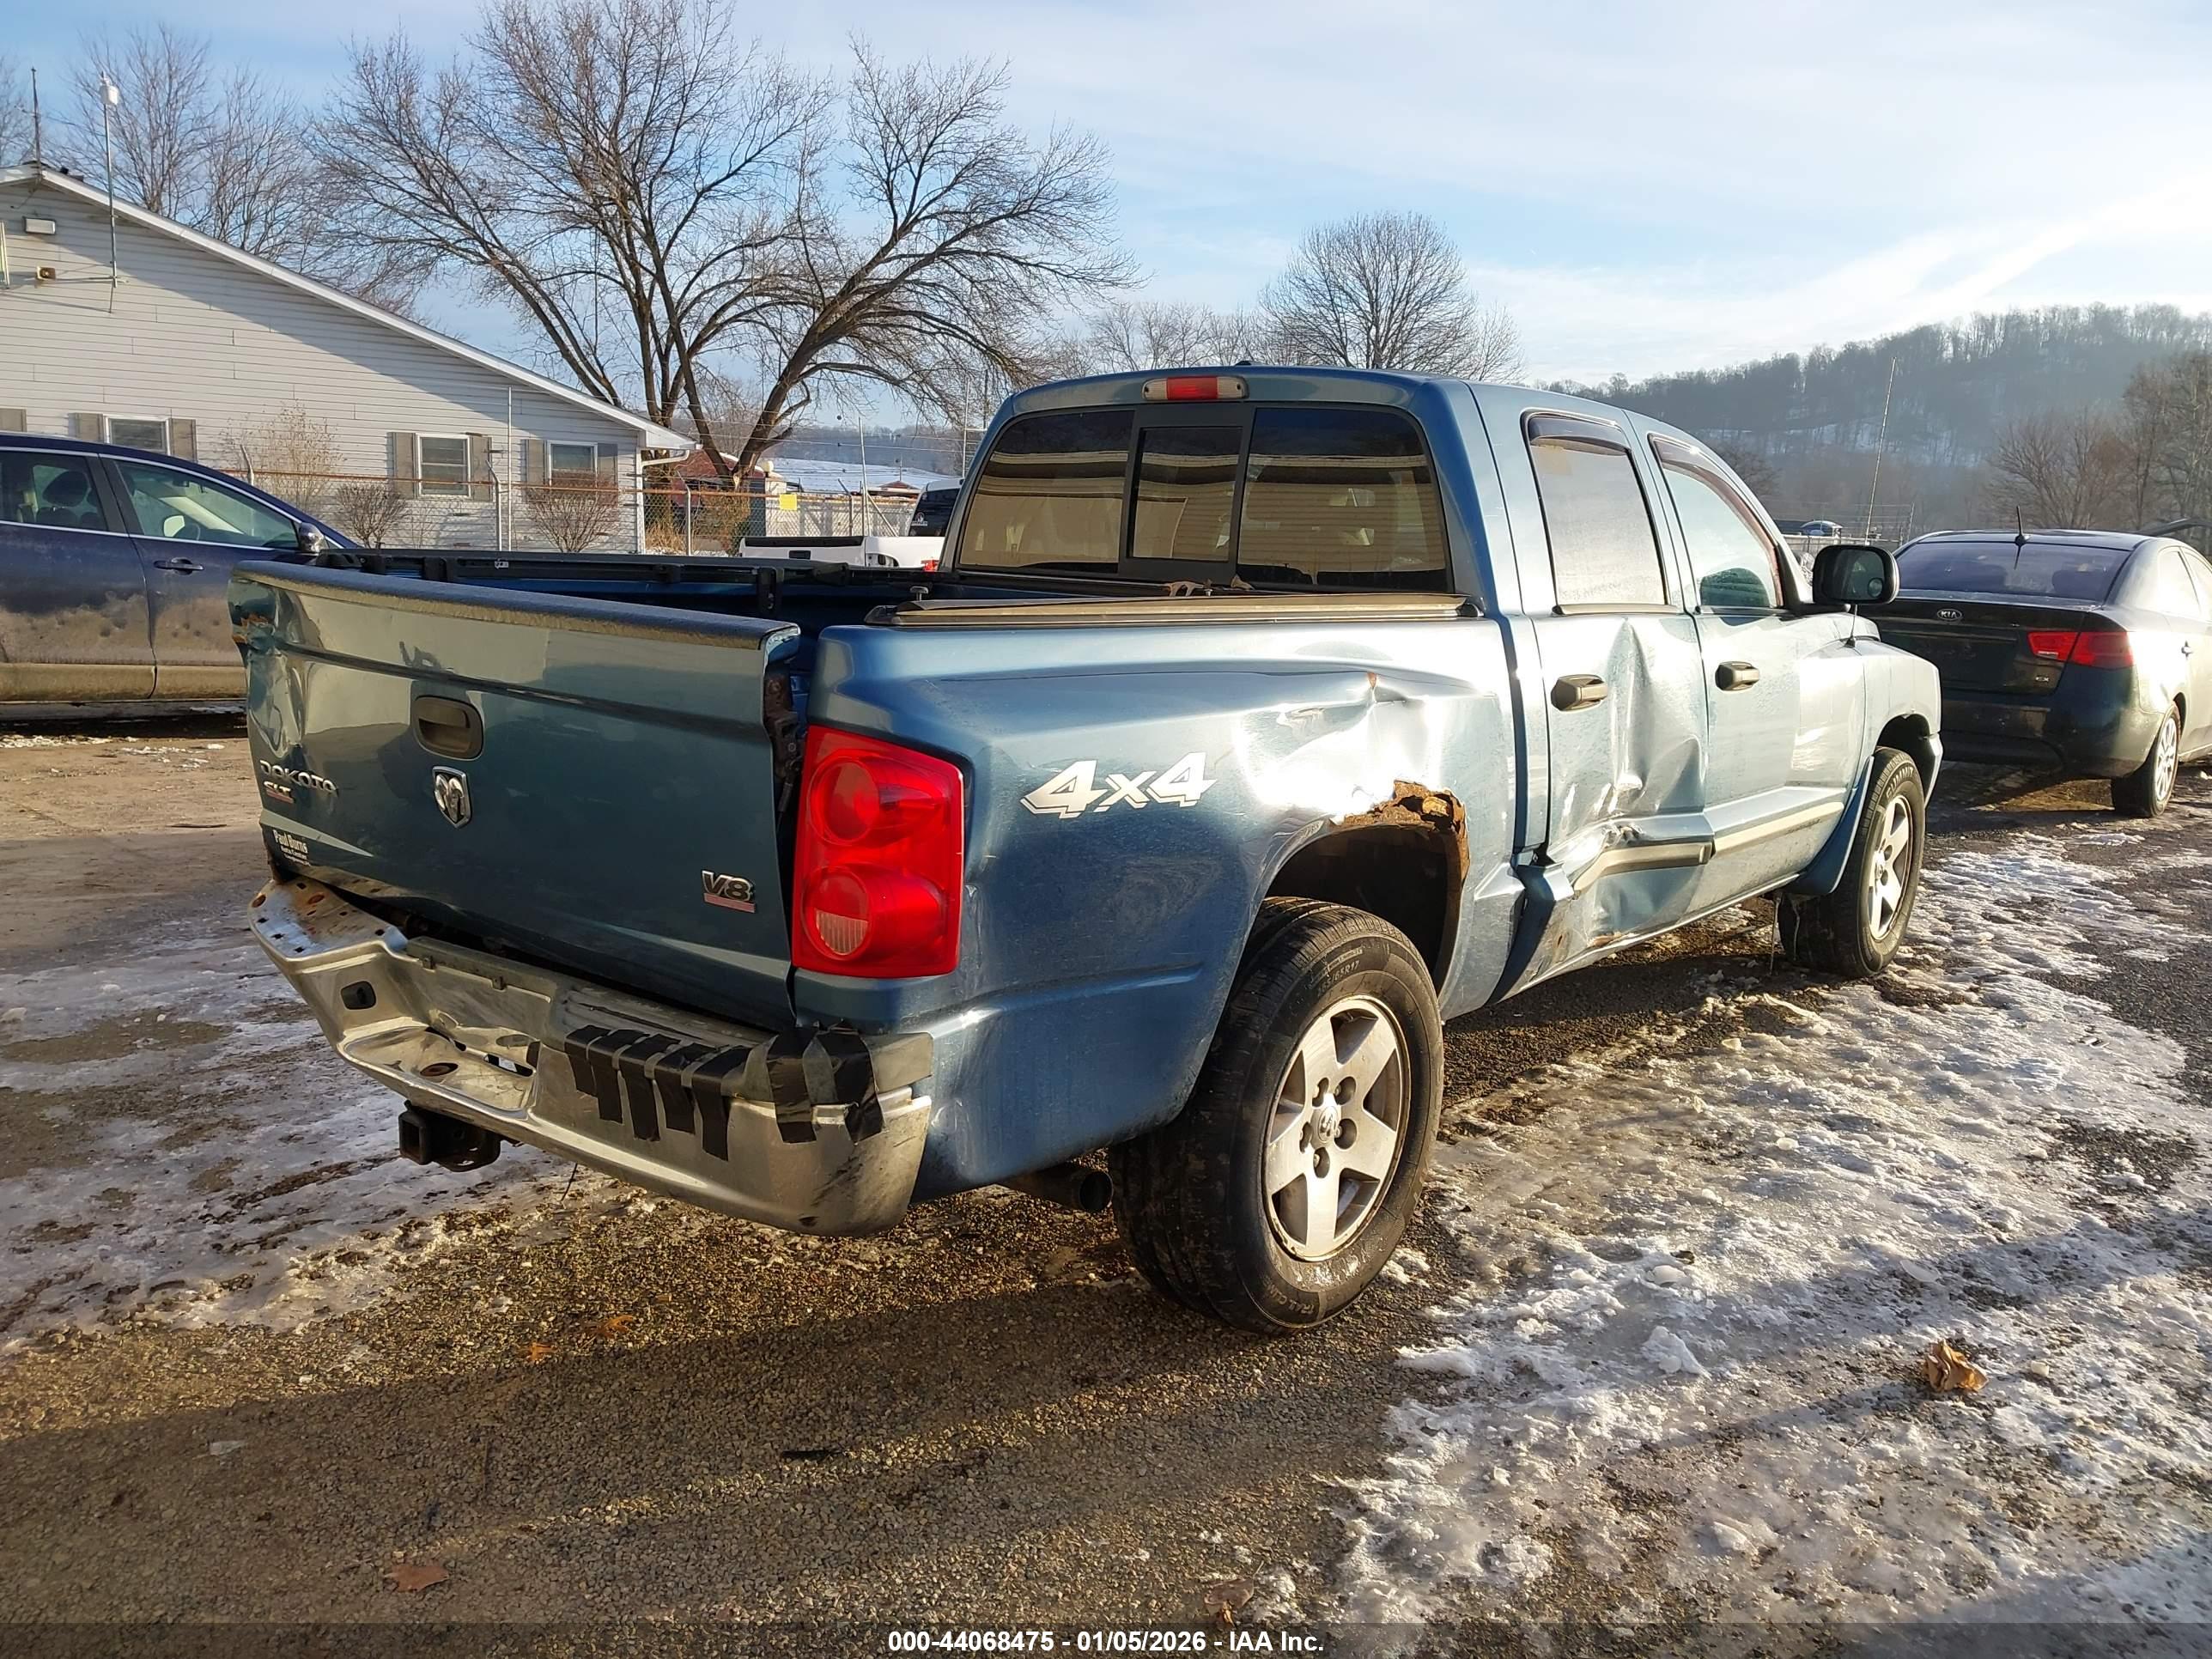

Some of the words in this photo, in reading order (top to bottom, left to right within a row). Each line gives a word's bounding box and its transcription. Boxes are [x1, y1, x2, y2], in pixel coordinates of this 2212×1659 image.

[1940, 610, 1958, 619] KIA
[1019, 751, 1218, 819] 4x4
[1886, 766, 1914, 800] SUMMIT
[702, 870, 753, 902] V8
